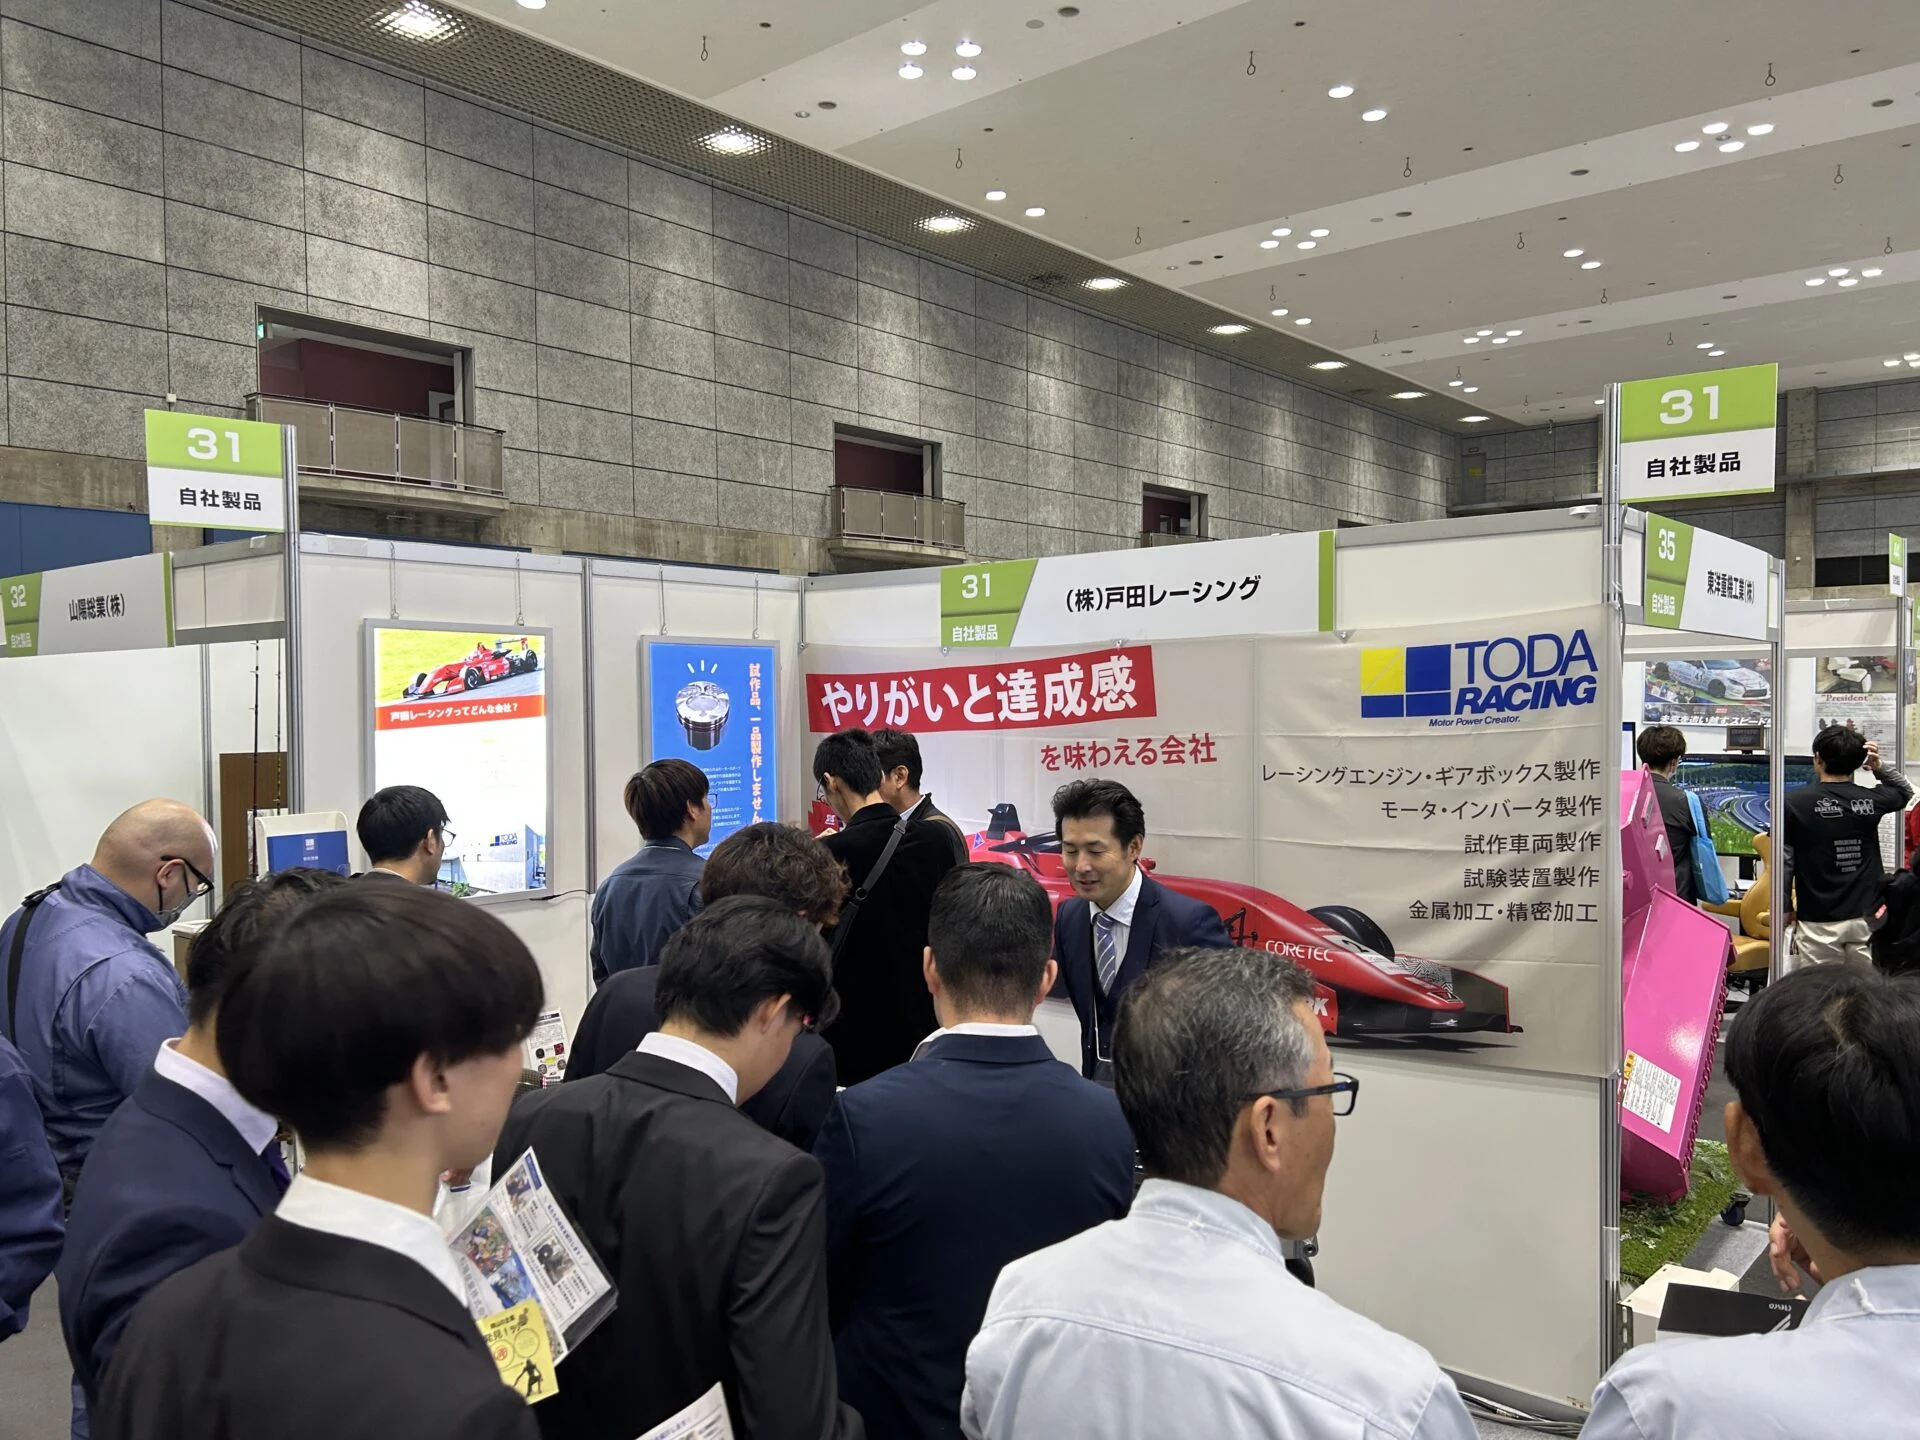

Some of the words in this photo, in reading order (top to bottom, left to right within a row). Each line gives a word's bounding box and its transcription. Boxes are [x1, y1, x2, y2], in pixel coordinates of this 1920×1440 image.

[1659, 385, 1720, 425] 31
[187, 427, 241, 463] 31
[1647, 451, 1741, 479] 自社製品
[179, 487, 262, 512] 自社製品
[1658, 528, 1676, 561] 35
[10, 584, 27, 608] 32
[961, 573, 992, 599] 31
[1065, 574, 1262, 613] (株)戸田レーシング
[952, 625, 999, 642] 自社製品
[1455, 629, 1599, 685] TODA
[820, 654, 1138, 728] やりがいと達成感
[1454, 675, 1597, 715] RACING
[1428, 718, 1454, 727] Motor
[1455, 717, 1483, 727] Power
[1484, 715, 1521, 725] Creator.
[1040, 732, 1218, 773] を味わえる会社
[1262, 758, 1602, 788] レーシングエンジン・ギアボックス製作
[1380, 795, 1602, 821] モータ・インバータ製作
[1464, 831, 1602, 855] 試作車両製作
[1463, 866, 1601, 889] 試験装置製作
[1408, 900, 1599, 924] 金属加工・精密加工
[1265, 939, 1334, 963] CORETEC
